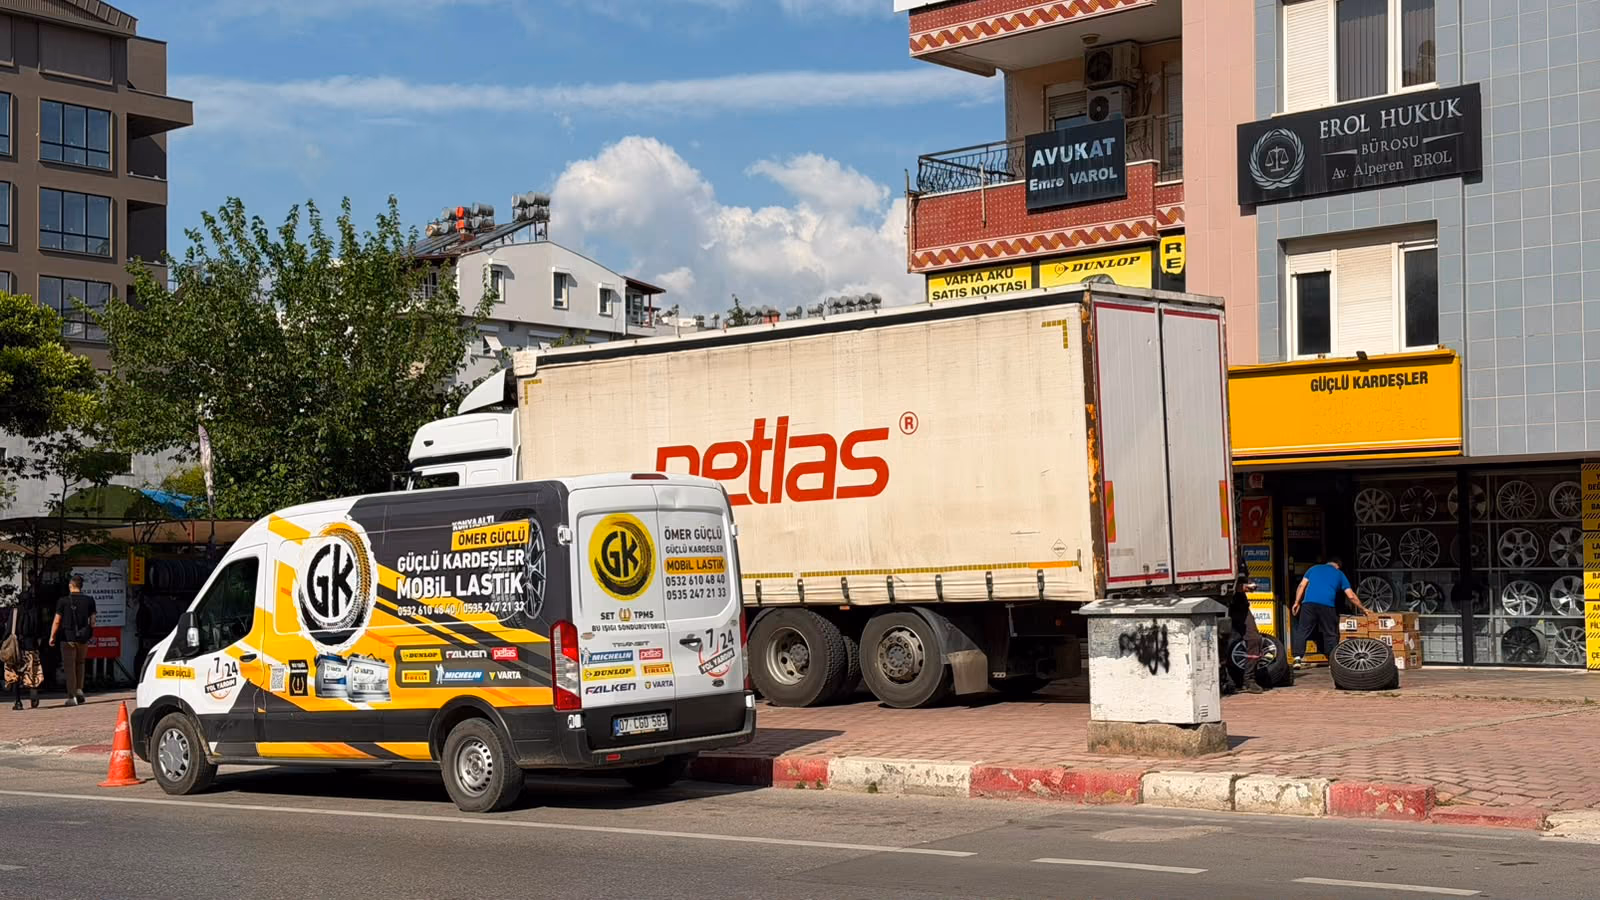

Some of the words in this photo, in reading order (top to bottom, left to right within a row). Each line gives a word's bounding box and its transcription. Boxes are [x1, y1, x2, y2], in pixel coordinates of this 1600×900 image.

[1320, 113, 1370, 139] EROL
[1380, 97, 1463, 129] HUKUK
[1032, 138, 1116, 168] AVUKAT
[1361, 136, 1419, 155] BÜROSU
[1332, 168, 1349, 180] Av.
[1353, 161, 1404, 177] Alperen
[1413, 150, 1452, 168] EROL
[1030, 177, 1065, 191] Emre
[1070, 166, 1118, 185] VAROL
[1071, 256, 1140, 272] DUNLOP
[944, 272, 983, 287] VARTA
[987, 266, 1014, 280] AKÜ
[971, 280, 1027, 297] NOKTASI
[1311, 374, 1349, 395] GÜÇLÜ
[1353, 371, 1428, 390] KARDEŞLER
[459, 530, 487, 546] ÖMER
[490, 526, 525, 545] GÜÇLÜ
[664, 525, 692, 540] ÖMER
[694, 525, 722, 542] GÜÇLÜ
[601, 530, 639, 578] GK
[665, 544, 687, 555] GÜÇLÜ
[689, 544, 723, 553] KARDEŞLER
[397, 550, 440, 575] GÜÇLÜ
[443, 549, 525, 570] KARDEŞLER
[307, 543, 354, 618] GK
[665, 576, 687, 587] 0532
[689, 575, 704, 586] 610
[705, 575, 715, 585] 48
[716, 574, 726, 584] 40
[666, 589, 688, 600] 0535
[689, 588, 704, 599] 247
[706, 588, 716, 598] 21
[717, 587, 727, 598] 33
[397, 605, 417, 617] 0532
[418, 604, 433, 616] 610
[463, 602, 483, 614] 0535
[484, 601, 499, 613] 247
[502, 601, 511, 612] 21
[515, 600, 525, 611] 33
[600, 611, 615, 620] SET
[633, 610, 654, 619] TPMS
[705, 627, 713, 649] 7
[720, 629, 734, 650] 24
[446, 650, 487, 659] FALKEN
[591, 651, 632, 661] MICHELIN
[214, 657, 220, 674] 7
[224, 661, 238, 677] 24
[444, 671, 482, 679] MICHELIN
[497, 670, 522, 679] VARTA
[593, 668, 632, 677] DUNLOP
[643, 663, 671, 674] PIRELLI
[585, 683, 637, 694] FALKEN
[652, 680, 674, 688] VARTA
[620, 719, 628, 731] 07
[652, 714, 666, 727] 583
